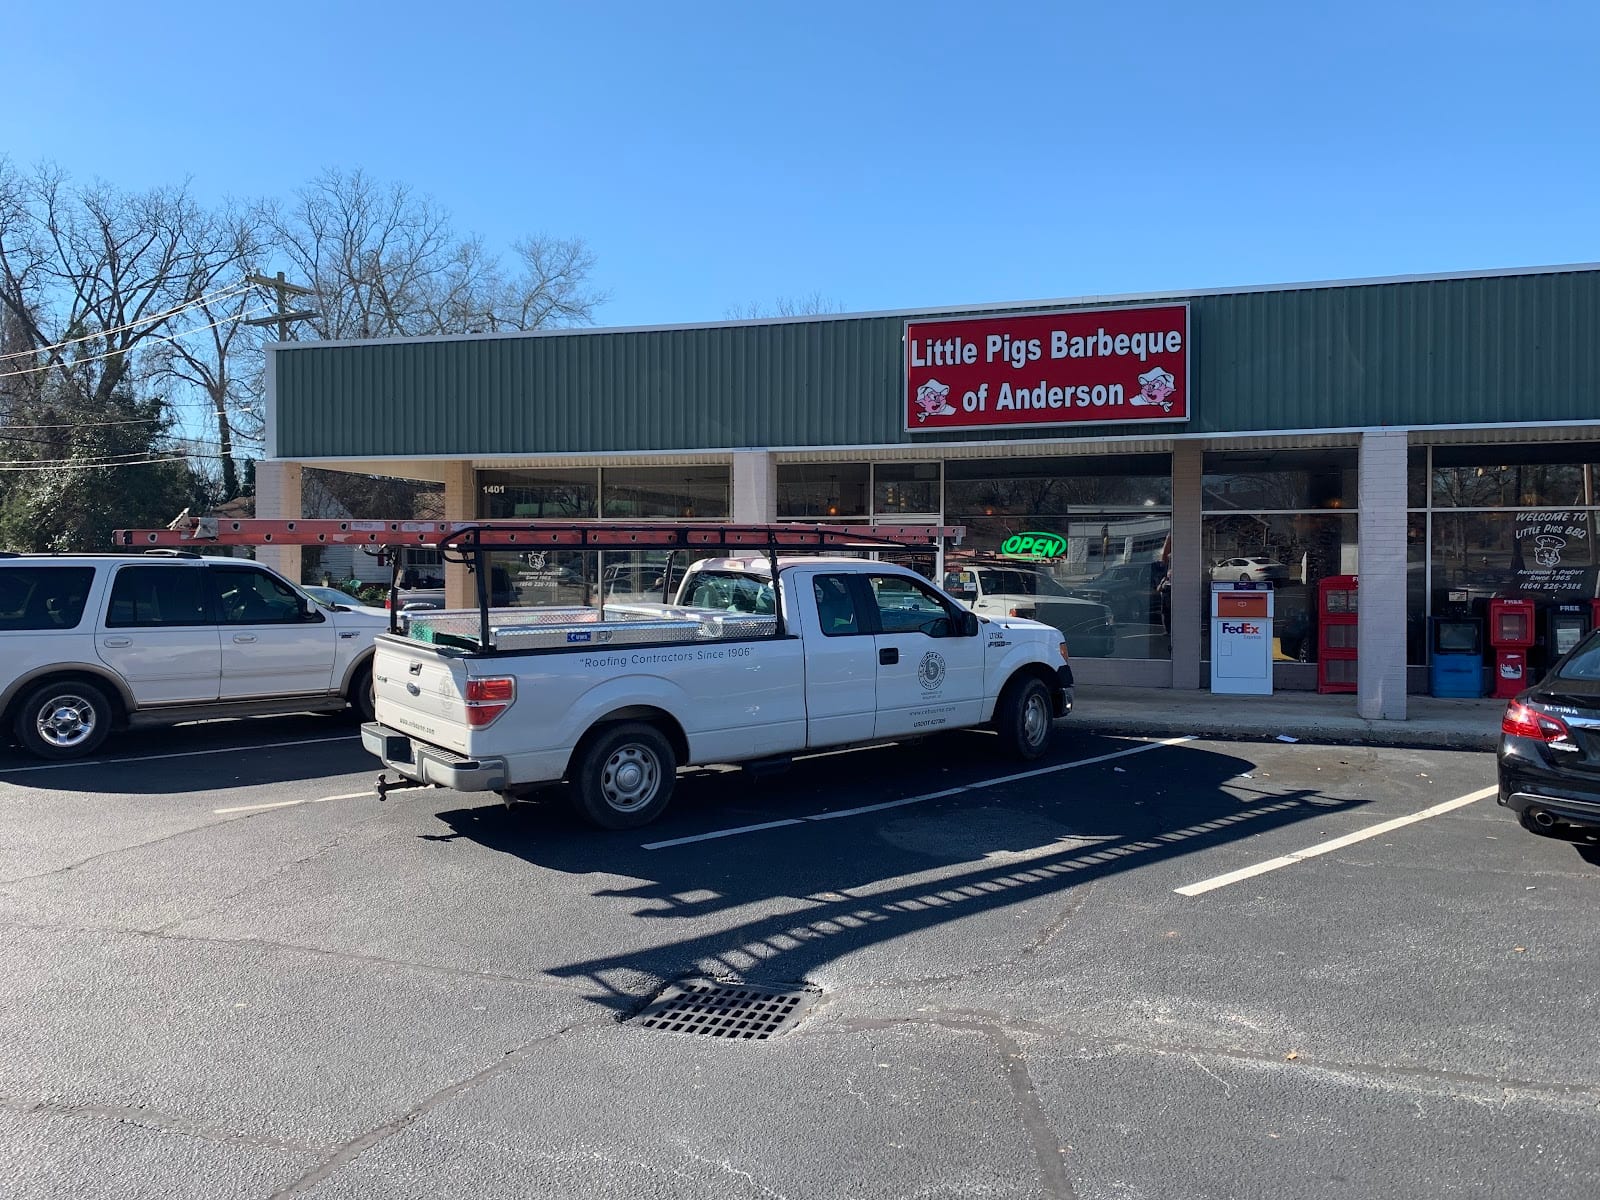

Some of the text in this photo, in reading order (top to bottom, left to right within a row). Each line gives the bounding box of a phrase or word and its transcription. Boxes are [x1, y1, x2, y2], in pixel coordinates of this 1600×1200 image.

[911, 328, 1182, 369] Little Pigs Barbeque
[962, 380, 1124, 413] of Anderson
[482, 485, 505, 494] 1401
[1515, 512, 1587, 521] WELCOME TO
[1515, 524, 1587, 539] LITTLE PIGS BBQ
[1005, 535, 1060, 557] OPEN
[1222, 622, 1259, 634] FedEx
[631, 651, 693, 664] Contractors
[697, 649, 724, 660] Since
[1543, 704, 1579, 715] ALTIMA
